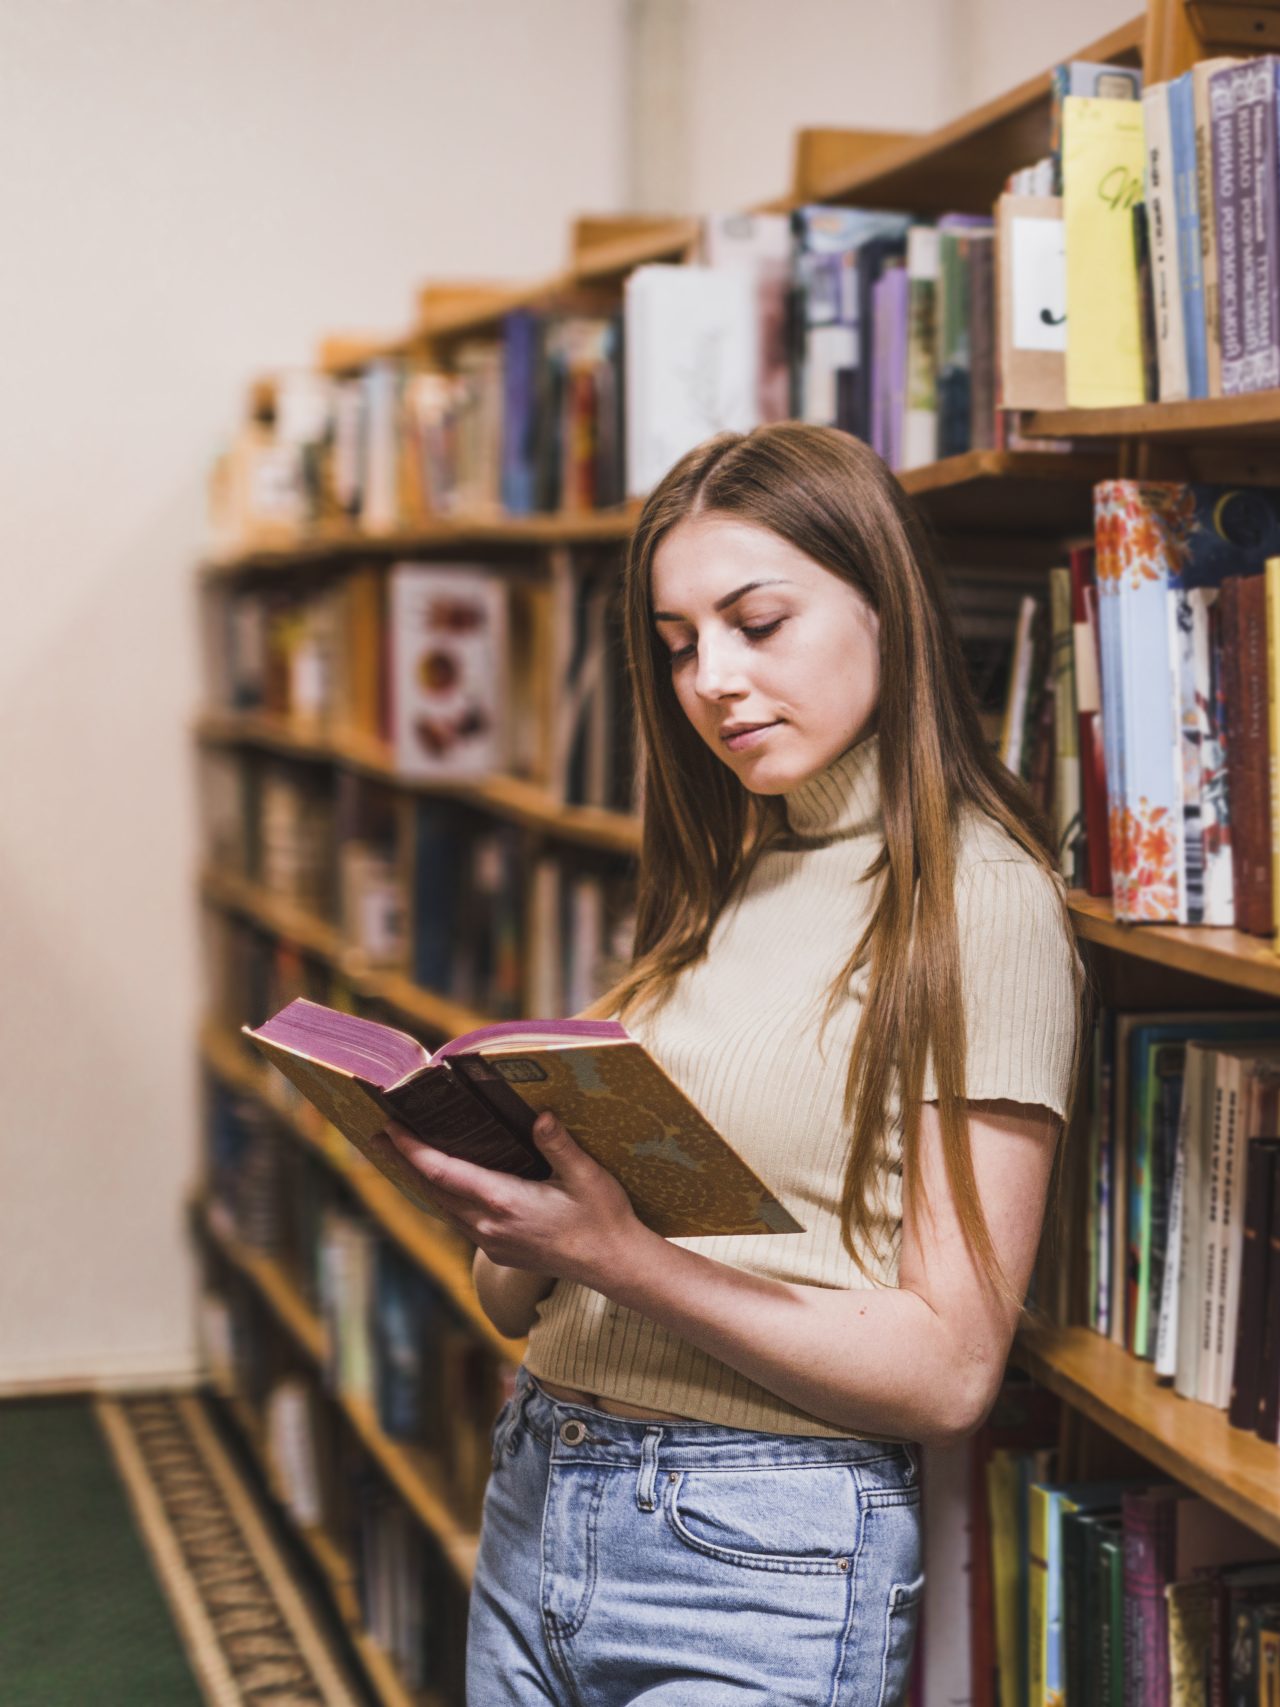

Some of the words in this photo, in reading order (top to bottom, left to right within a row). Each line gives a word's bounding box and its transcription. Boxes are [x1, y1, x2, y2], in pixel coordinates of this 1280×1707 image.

[1218, 118, 1235, 198] КИРИЛО
[1237, 108, 1251, 188] КИРИЛО
[1221, 206, 1241, 357] РОЗУМОВСЬКИЙ
[1240, 197, 1258, 352] РОЗУМОВСЬКИЙ
[1255, 255, 1270, 347] ГЕТЬМАН
